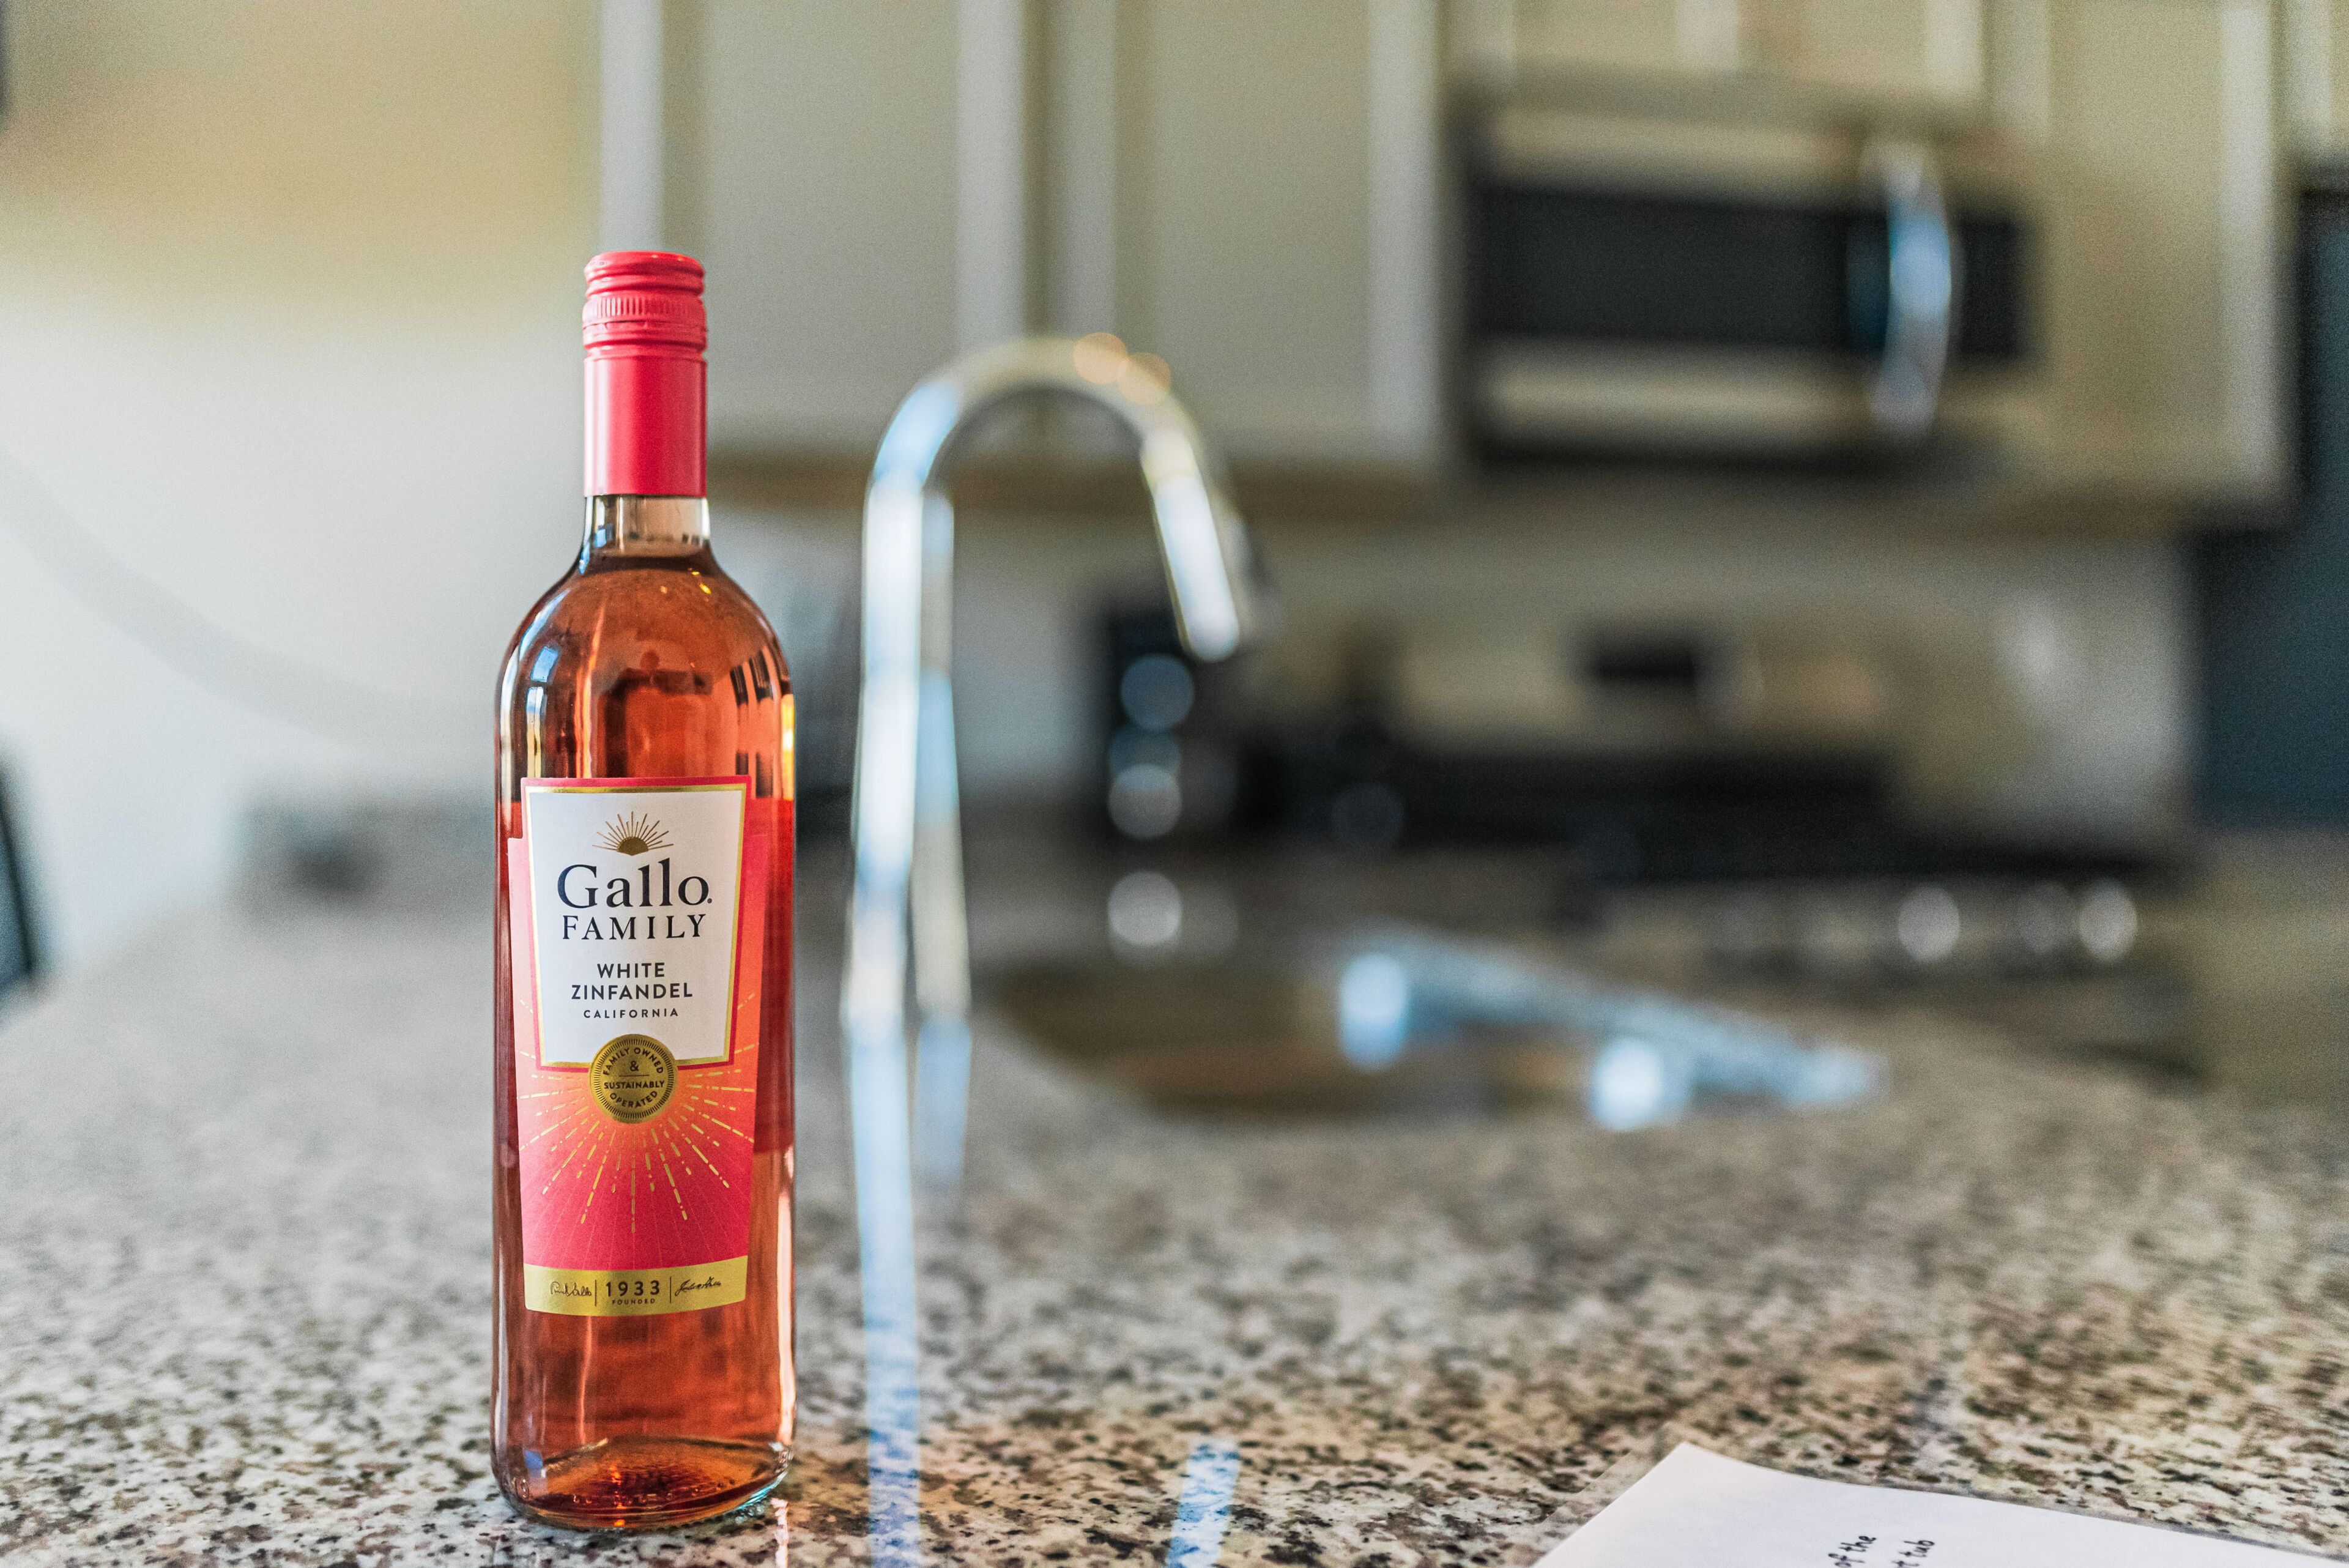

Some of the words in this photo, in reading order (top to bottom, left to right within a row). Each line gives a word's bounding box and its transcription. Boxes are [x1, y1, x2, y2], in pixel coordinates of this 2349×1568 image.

[557, 857, 710, 909] Gallo
[562, 913, 707, 940] FAMILY
[597, 962, 666, 979] WHITE
[571, 983, 693, 1000] ZINFANDEL
[584, 1008, 679, 1019] CALIFORNIA
[603, 1047, 630, 1076] FAMILY
[634, 1047, 664, 1074] OWNED
[629, 1060, 639, 1072] &
[604, 1080, 665, 1090] SUSTAINABLY
[609, 1090, 658, 1109] OPERATED
[606, 1280, 660, 1297] 1933
